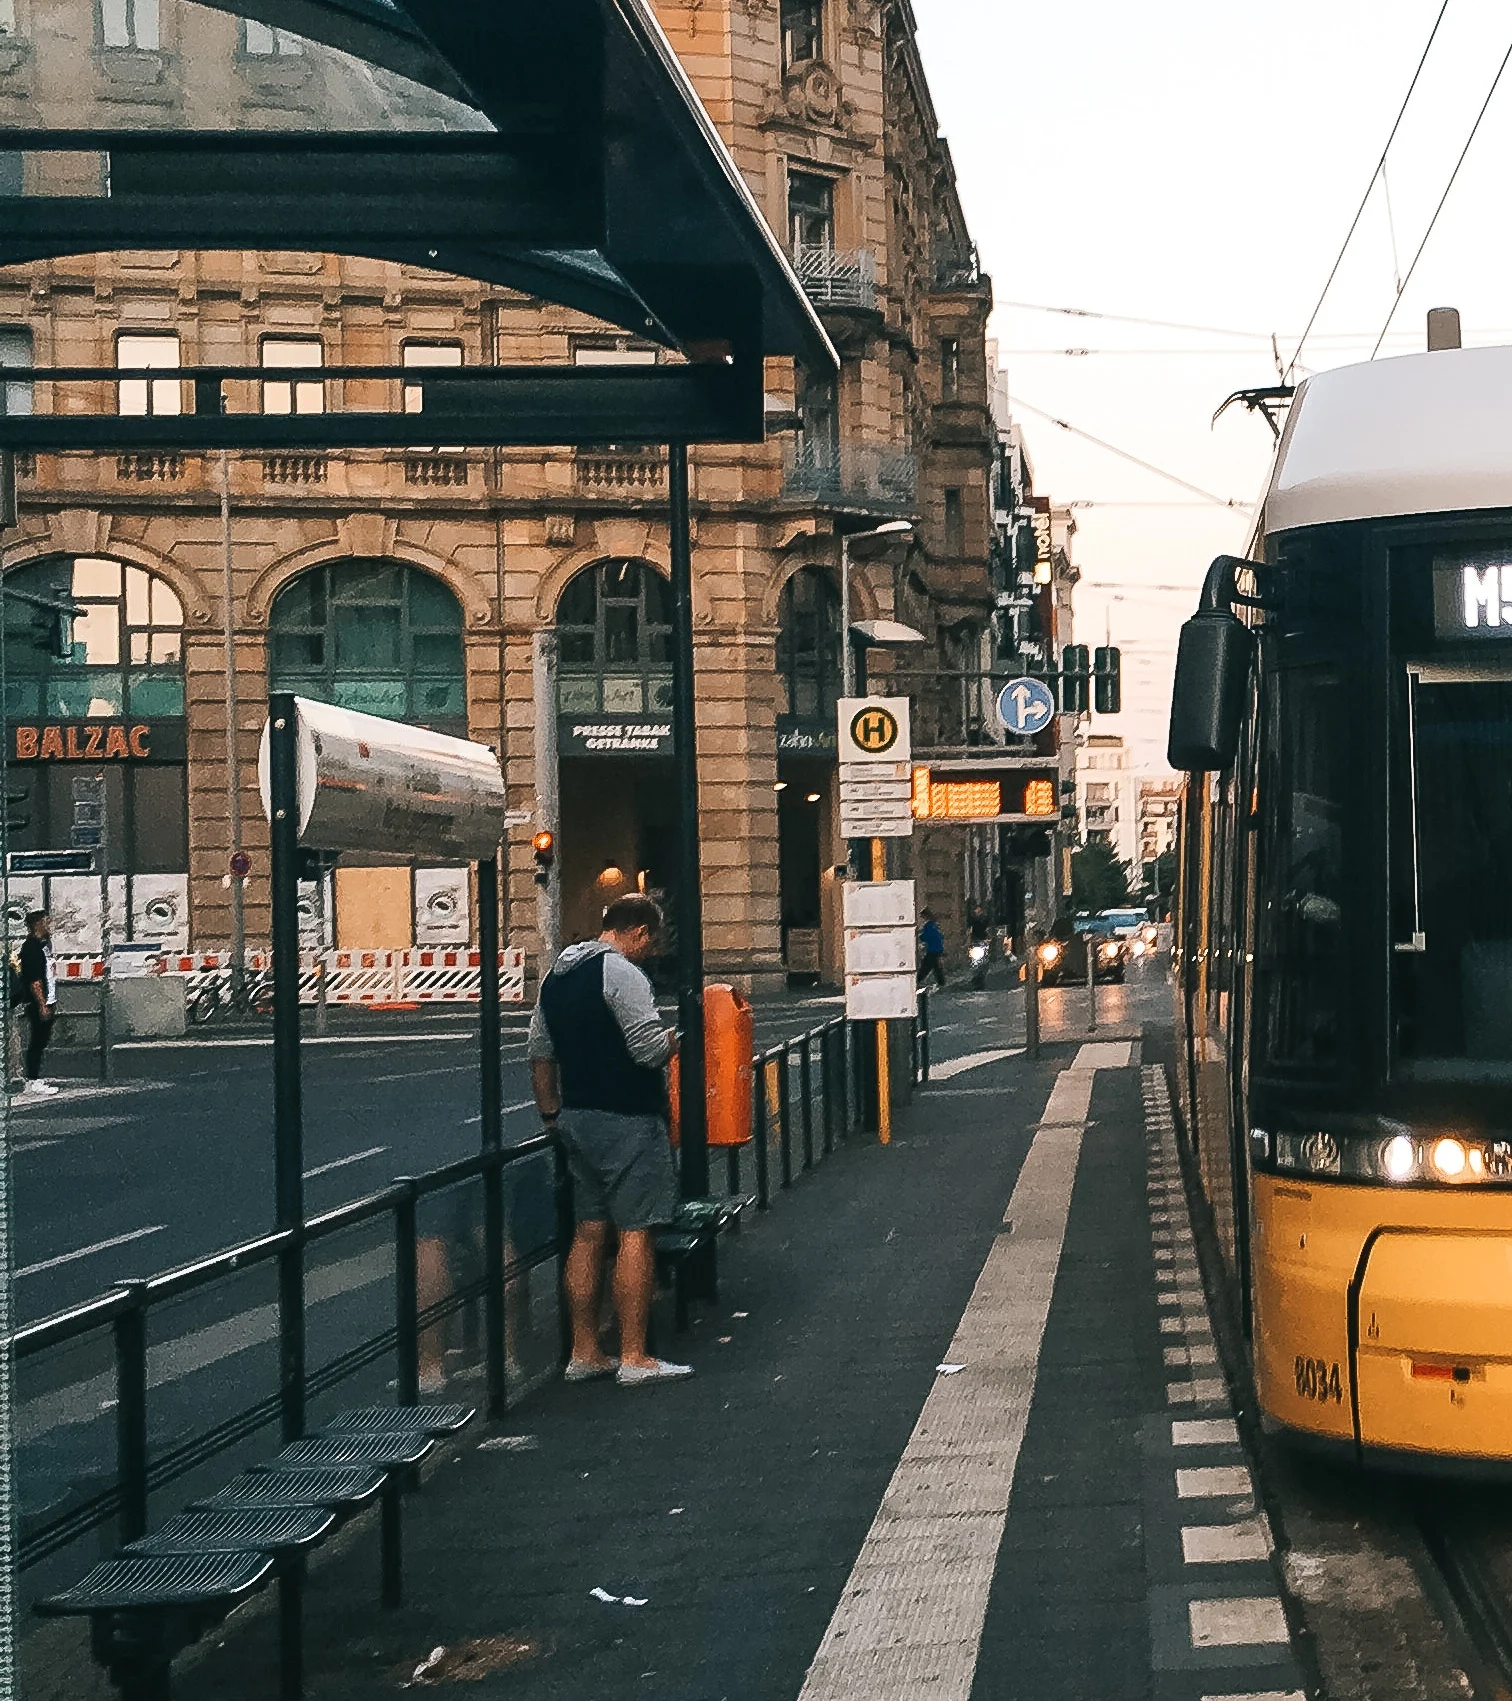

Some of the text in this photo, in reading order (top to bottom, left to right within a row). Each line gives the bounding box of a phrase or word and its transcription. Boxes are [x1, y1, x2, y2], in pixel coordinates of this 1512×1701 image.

[16, 725, 150, 759] BALZAC
[862, 716, 886, 743] H
[1293, 1355, 1343, 1405] 8034
